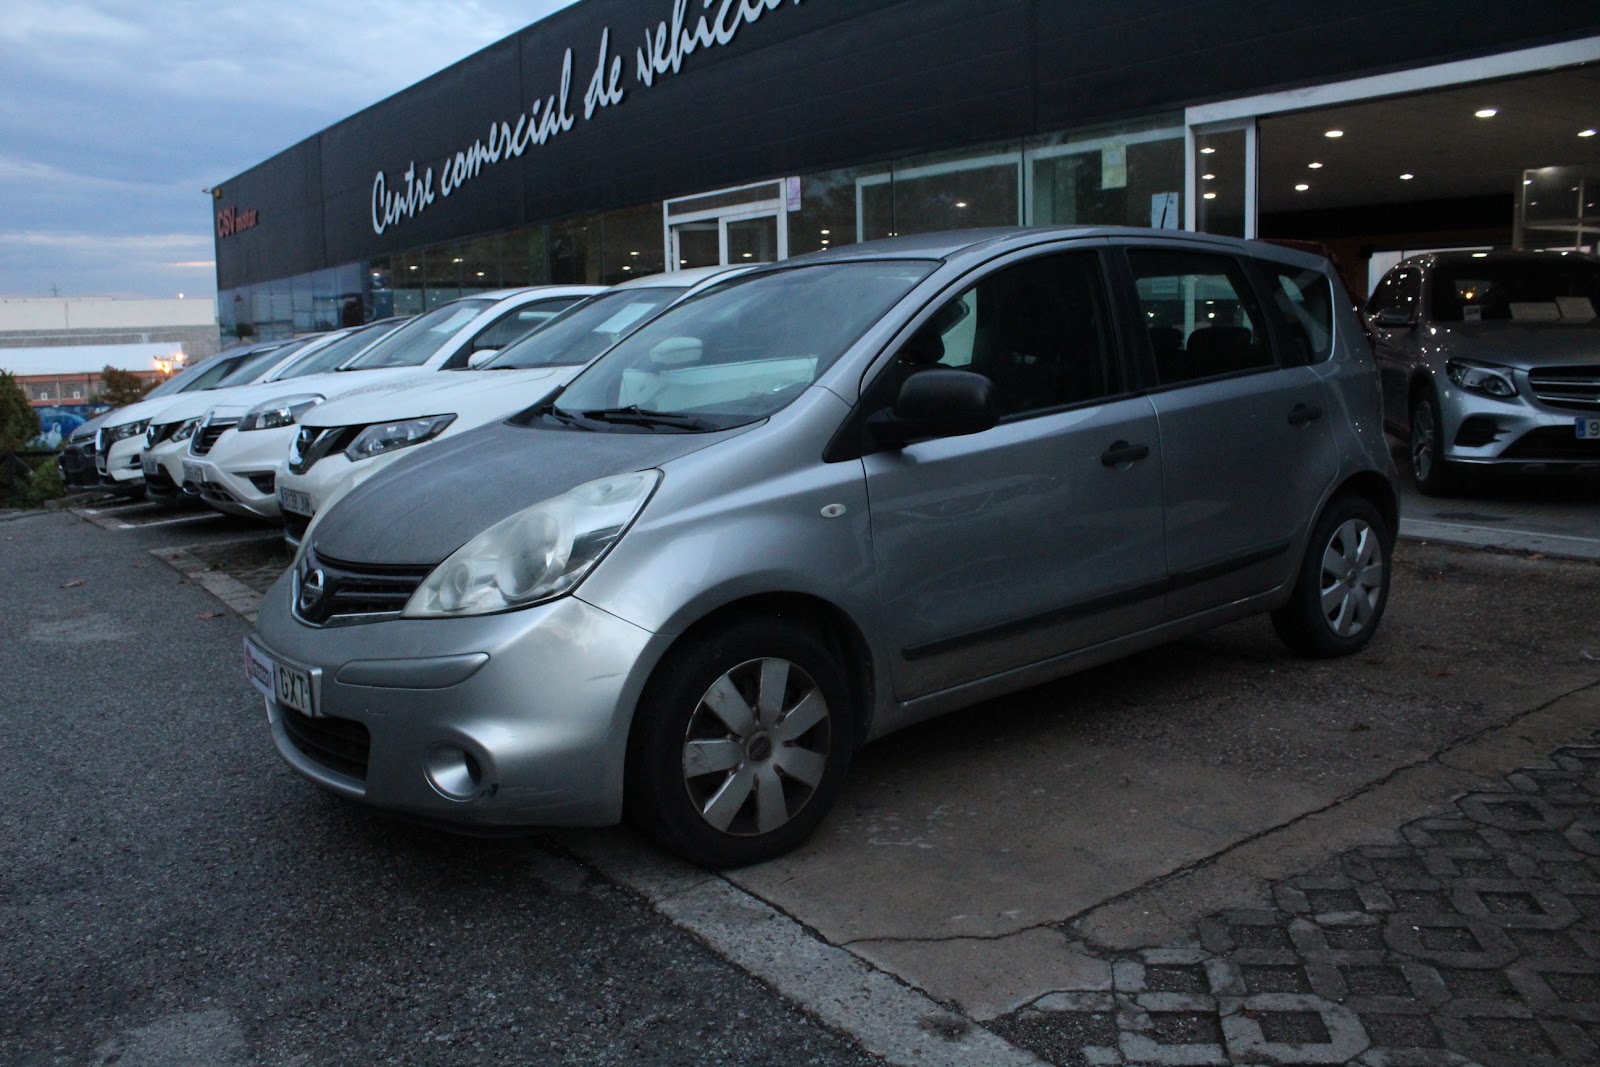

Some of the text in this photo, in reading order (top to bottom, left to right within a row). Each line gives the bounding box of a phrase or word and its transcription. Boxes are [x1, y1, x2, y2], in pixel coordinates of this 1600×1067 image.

[371, 161, 435, 235] Centre
[440, 47, 574, 197] comercial
[583, 27, 624, 120] de
[279, 666, 306, 709] GXT
